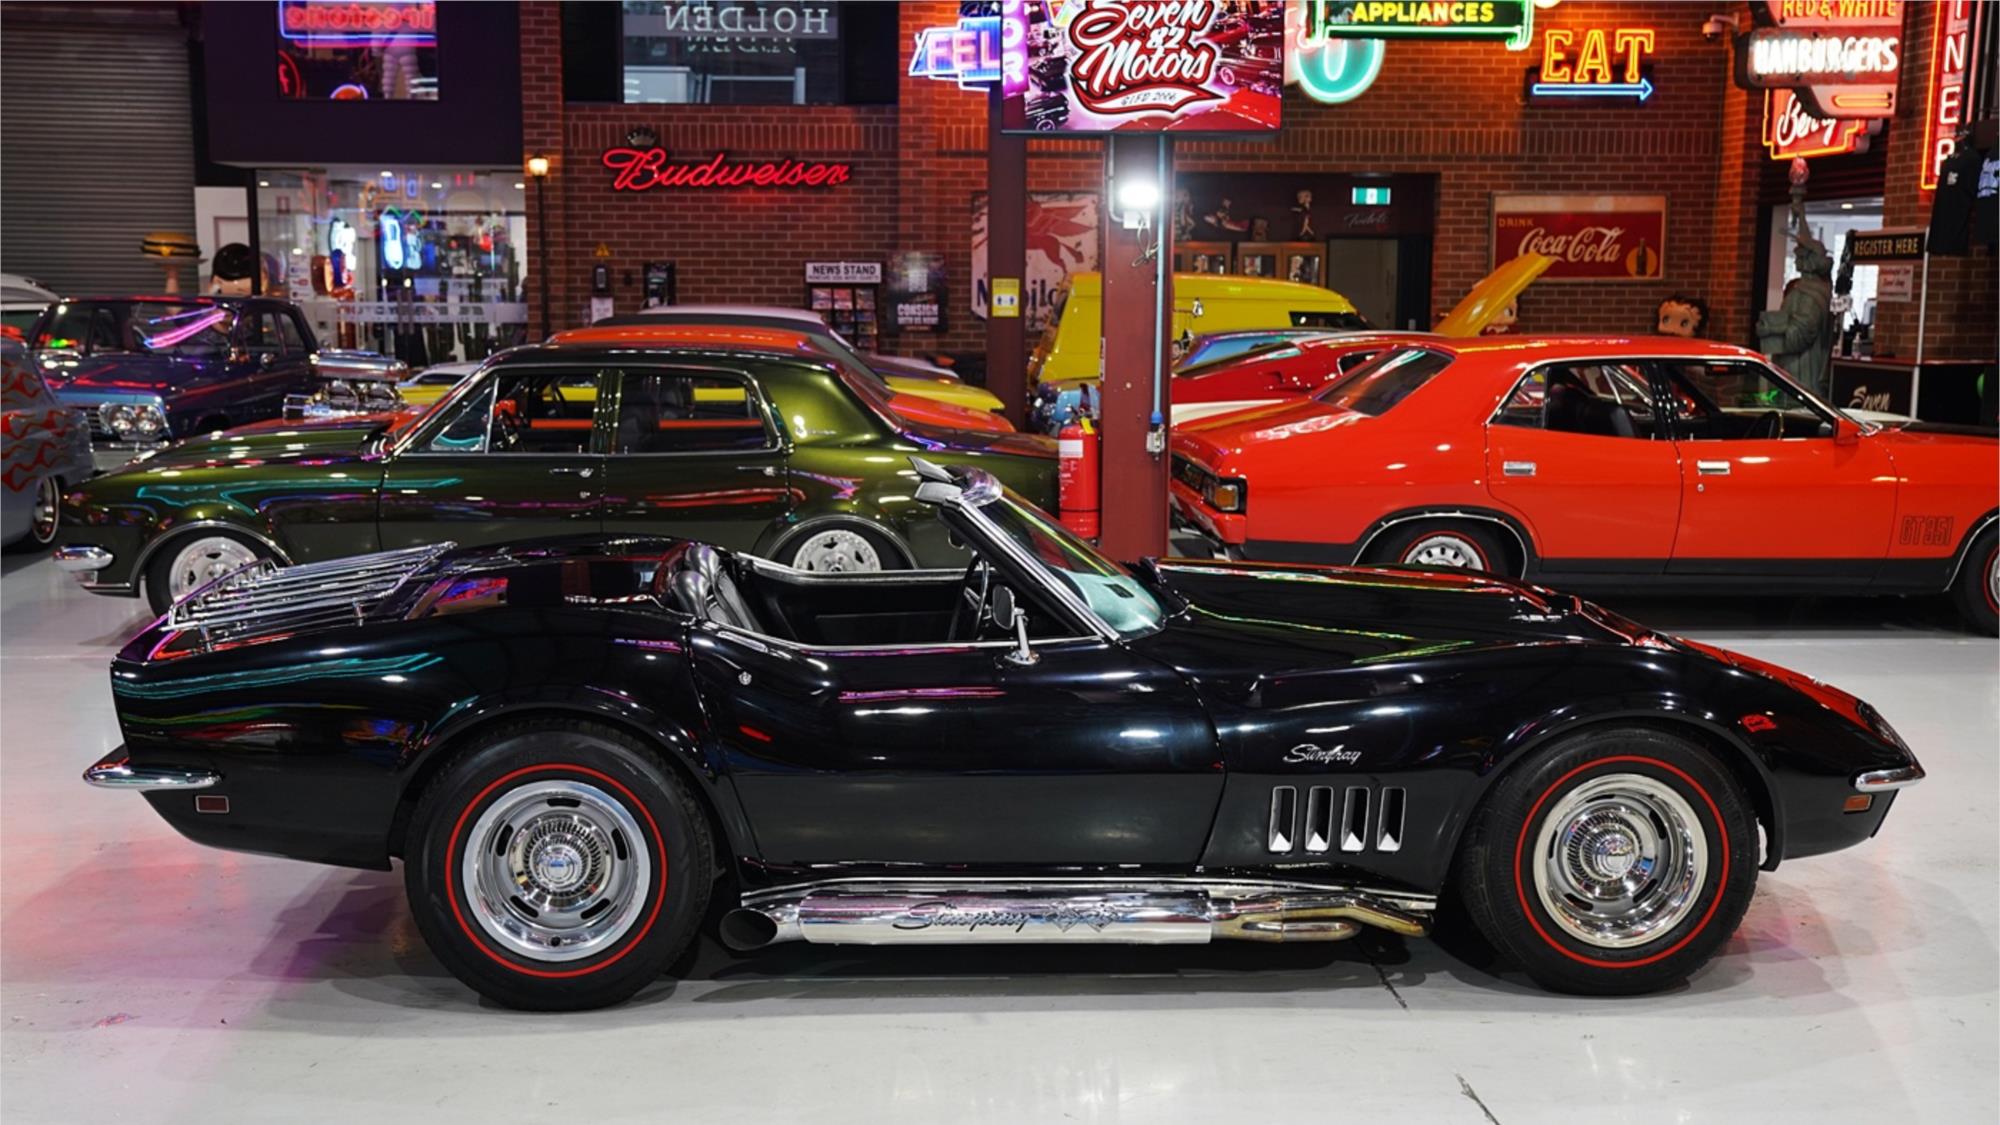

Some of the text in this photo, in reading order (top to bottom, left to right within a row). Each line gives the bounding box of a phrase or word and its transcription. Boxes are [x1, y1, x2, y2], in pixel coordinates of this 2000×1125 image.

[1352, 3, 1495, 23] APPLIANCES
[1783, 0, 1815, 17] RED
[1839, 0, 1897, 17] WHITE
[1075, 0, 1208, 46] Seven
[1146, 27, 1186, 49] 82
[1078, 39, 1210, 93] Motors
[1541, 29, 1655, 83] EAT
[1754, 37, 1899, 73] HAMBURGERS
[602, 148, 850, 190] Budweiser
[1498, 218, 1534, 228] DRINK
[1854, 237, 1919, 256] REGISTER HERE
[812, 265, 876, 275] NEWS STAND
[1850, 386, 1890, 412] Seven
[1282, 743, 1362, 766] Stingray
